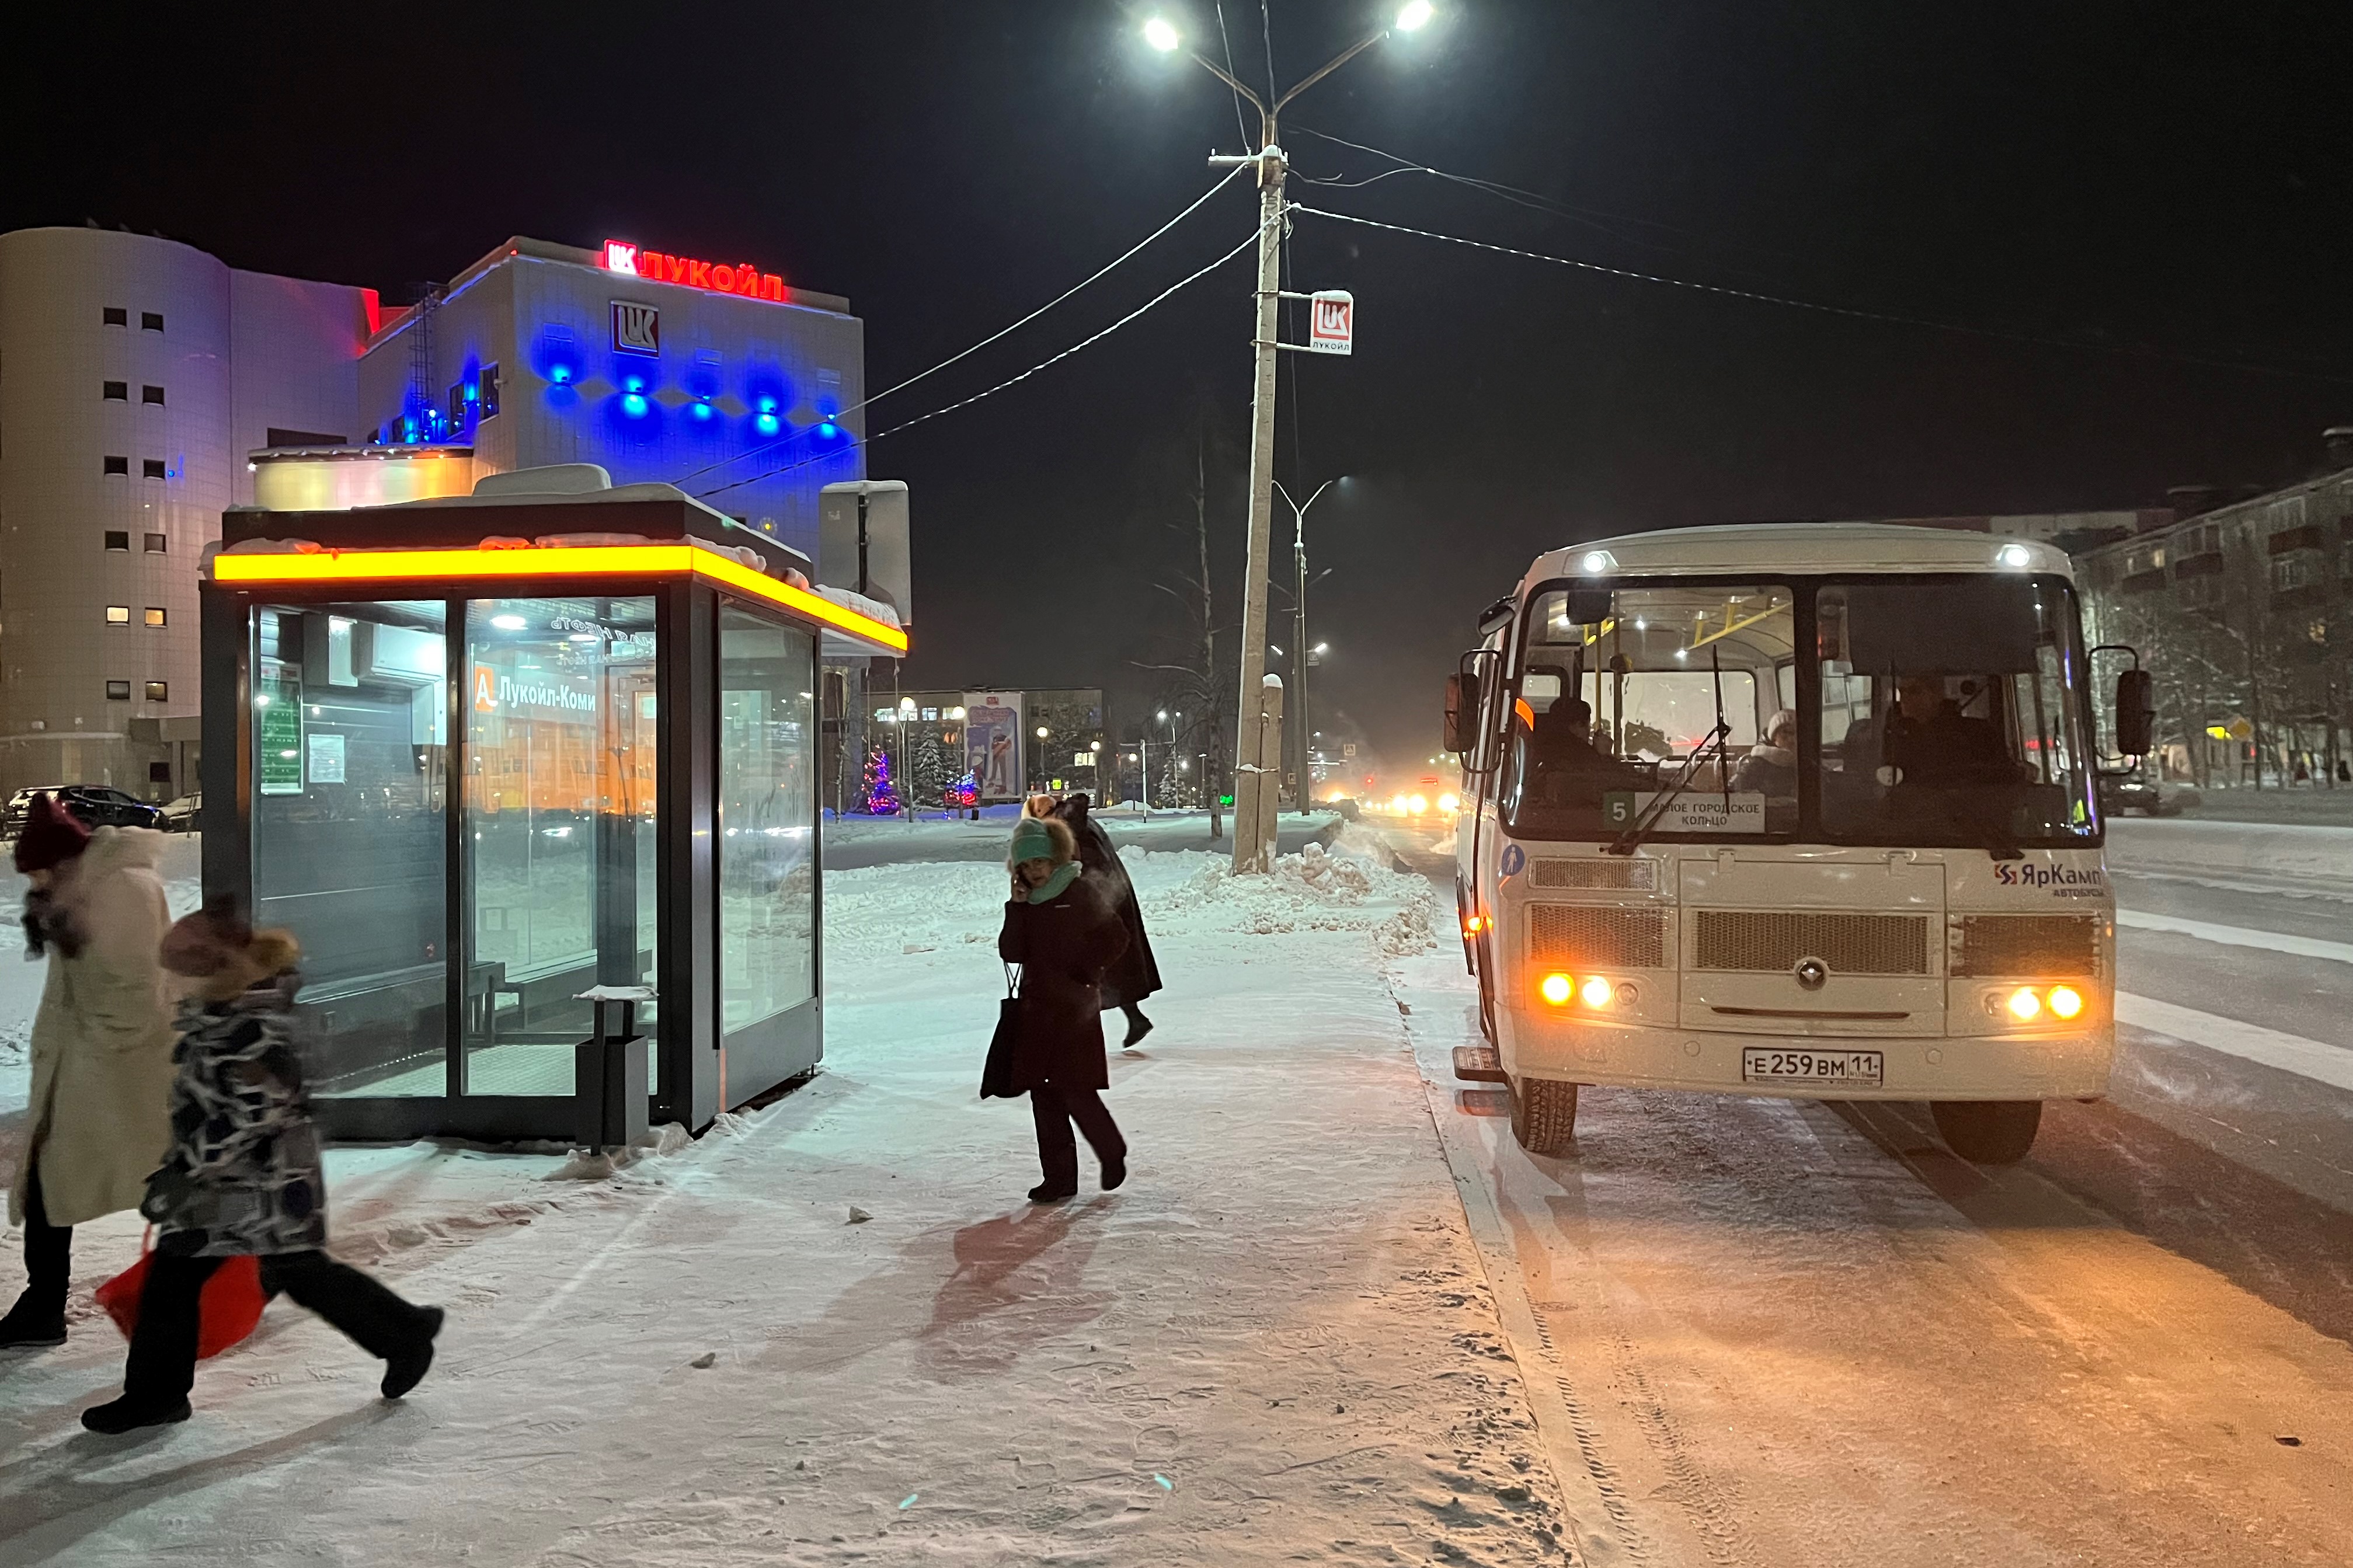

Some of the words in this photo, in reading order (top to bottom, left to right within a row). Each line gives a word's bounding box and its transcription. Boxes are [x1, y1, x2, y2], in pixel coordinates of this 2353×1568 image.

[640, 251, 782, 301] ЛУКОЙЛ
[1313, 342, 1349, 351] ЛУКОЙЛ
[499, 676, 596, 712] Лукойл-Коми
[1613, 802, 1626, 821] 5
[1682, 816, 1727, 827] КОЛЬЦО
[2021, 863, 2102, 888] ЯрКамп
